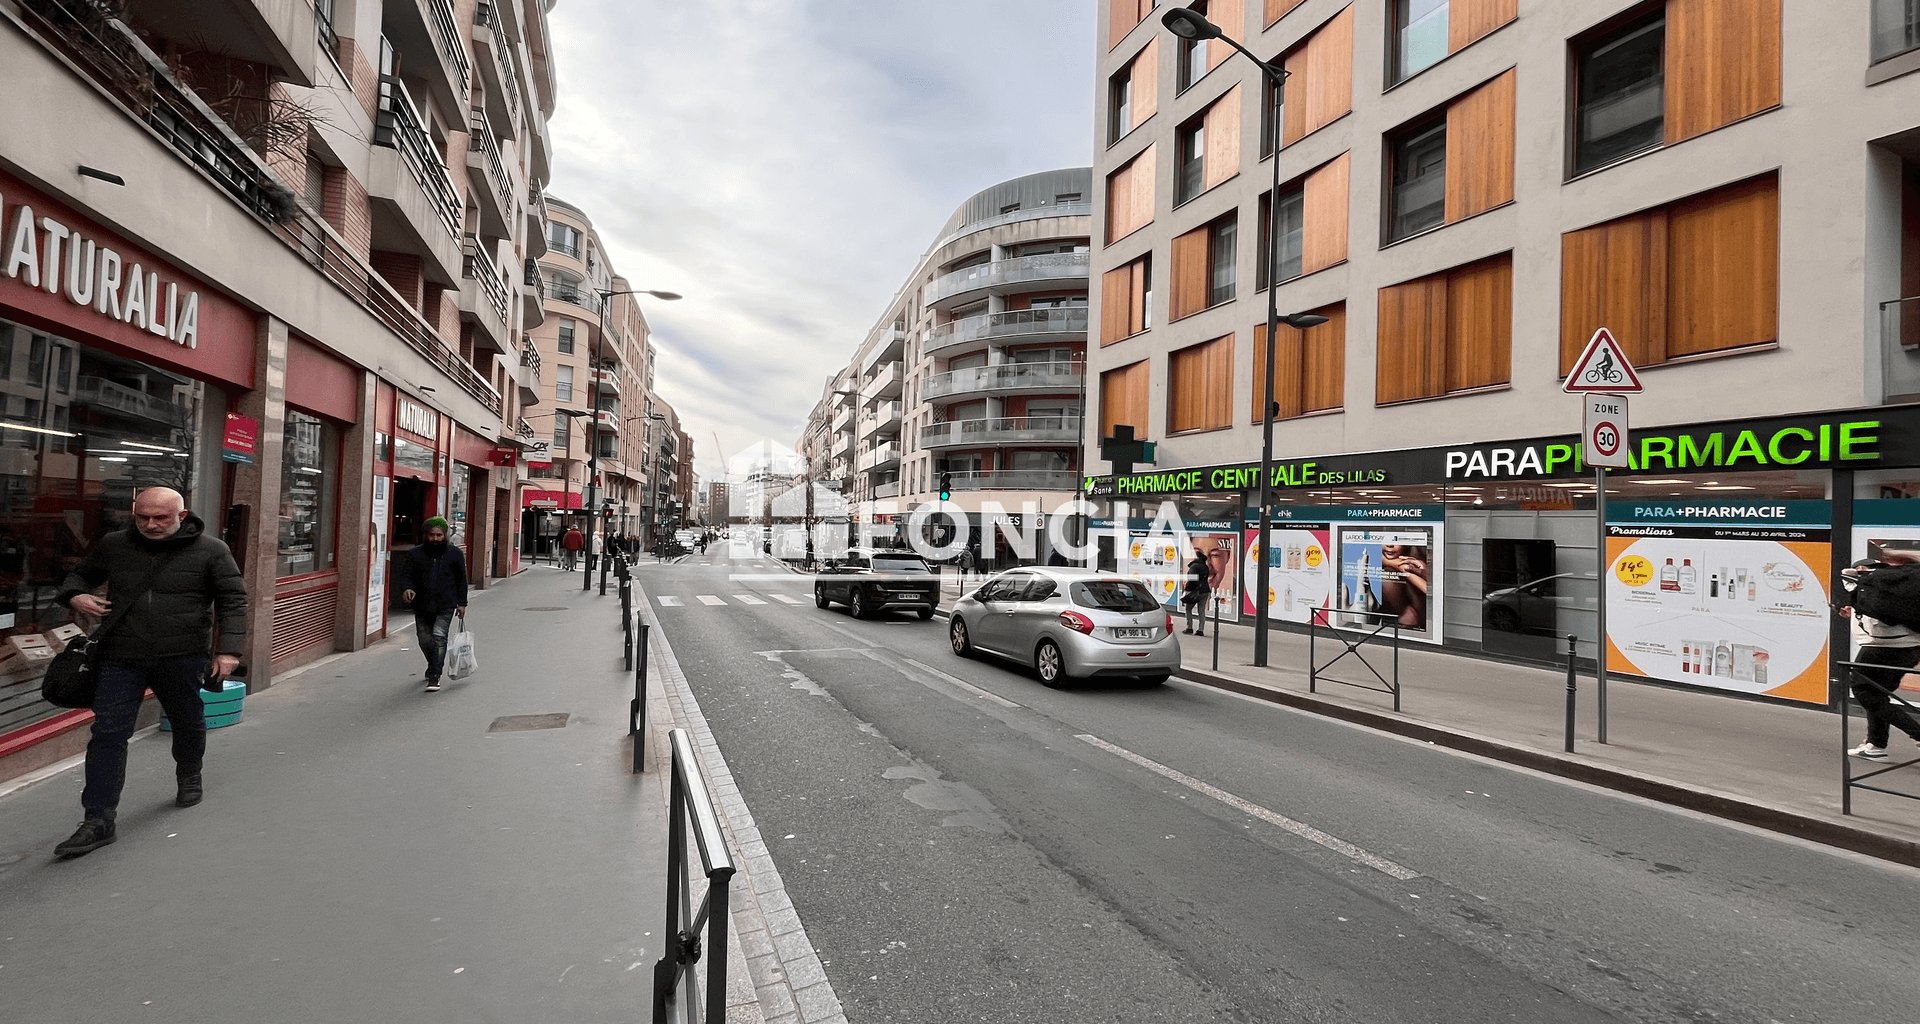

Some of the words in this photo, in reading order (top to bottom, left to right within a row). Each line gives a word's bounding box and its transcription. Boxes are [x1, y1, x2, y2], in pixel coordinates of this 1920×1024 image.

[0, 192, 199, 350] ATURALIA
[1594, 403, 1619, 414] ZONE
[399, 398, 437, 441] NATURALIA
[1598, 431, 1615, 447] 30
[1118, 471, 1202, 494] PHARMACIE
[1319, 470, 1345, 485] DES
[1347, 468, 1387, 483] LILAS
[1347, 508, 1422, 518] PARA+PHARMACIE
[1634, 506, 1786, 518] PARA+PHARMACIE
[989, 515, 1021, 526] JULES
[1610, 526, 1675, 537] Promotions
